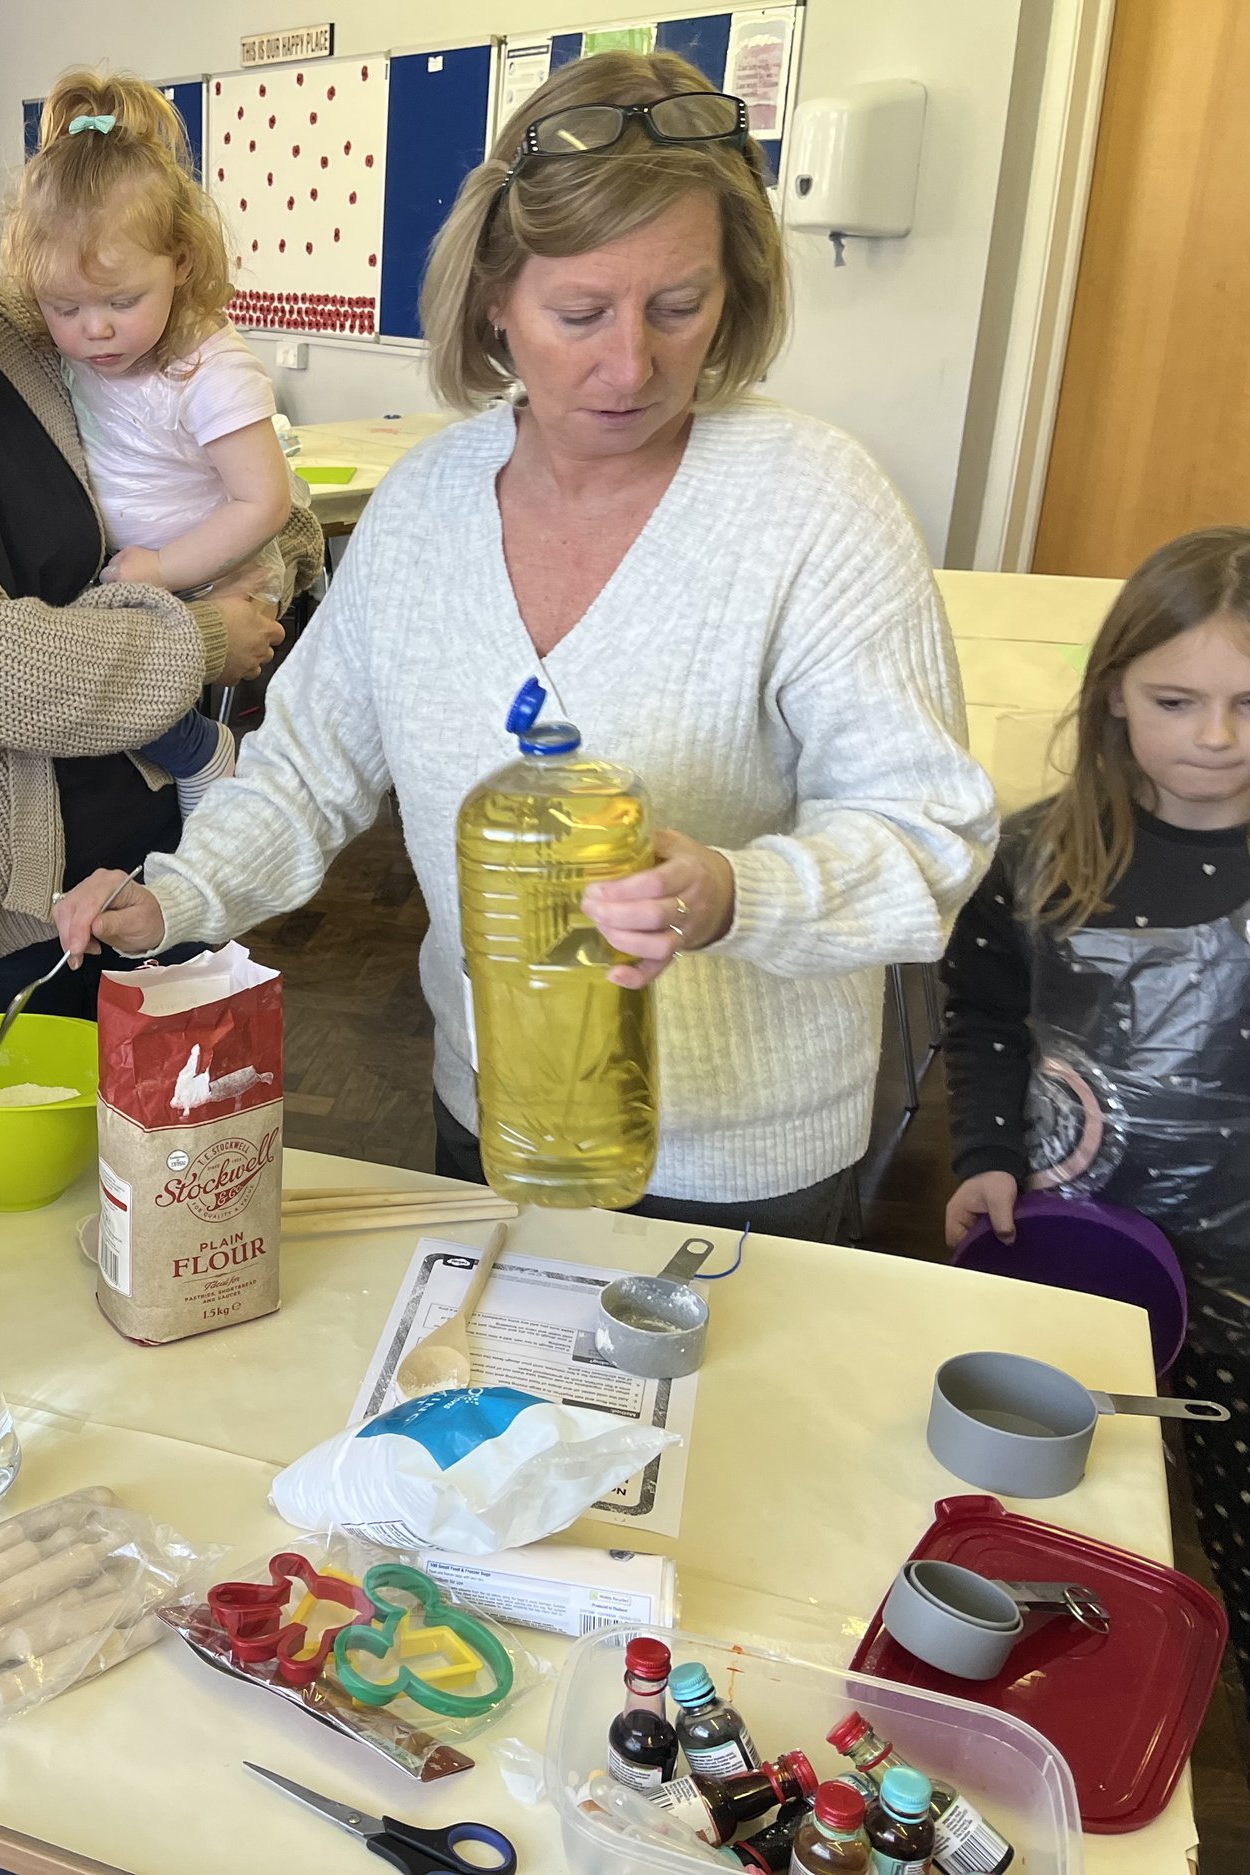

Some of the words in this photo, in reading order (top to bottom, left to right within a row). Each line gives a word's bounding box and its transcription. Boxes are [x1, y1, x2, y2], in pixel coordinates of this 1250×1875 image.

[241, 41, 256, 62] THIS
[258, 40, 265, 60] IS
[266, 38, 280, 59] OUR
[281, 34, 304, 57] HAPPY
[306, 30, 328, 53] PLACE
[155, 1126, 279, 1207] Stockwell
[172, 1237, 266, 1278] FLOUR
[200, 1231, 244, 1252] PLAIN
